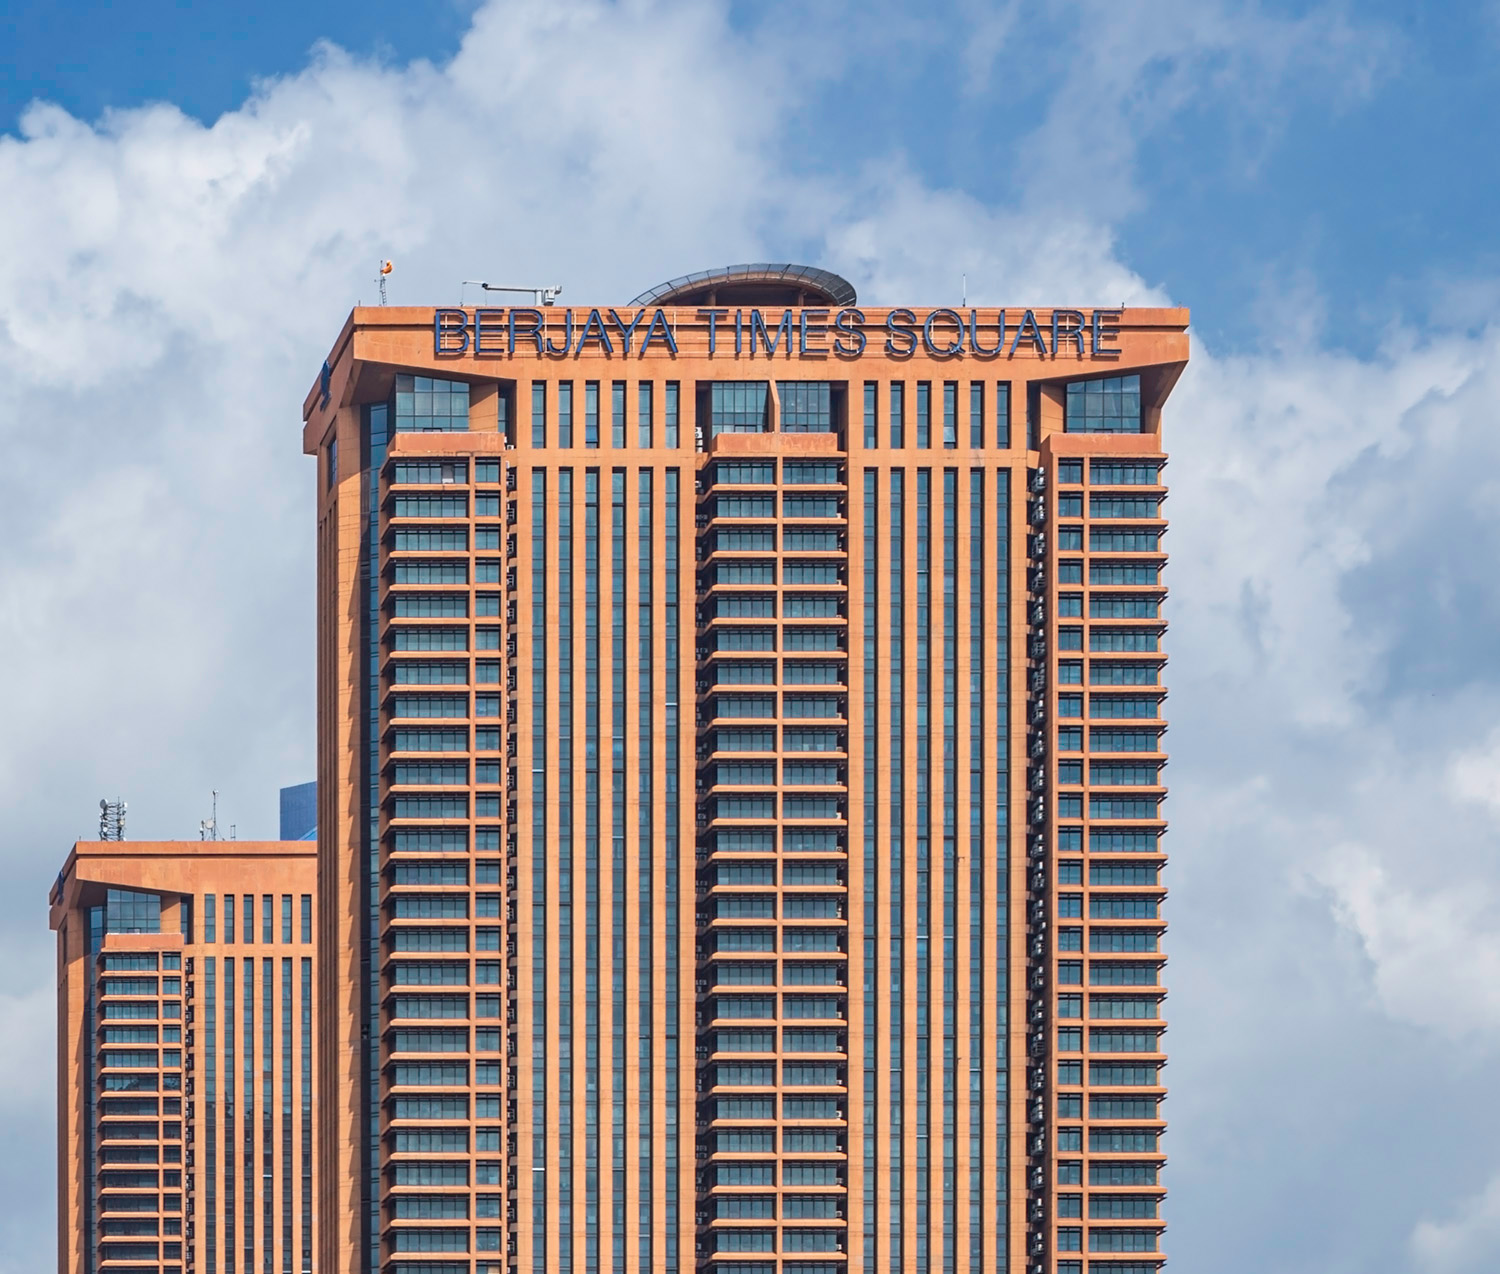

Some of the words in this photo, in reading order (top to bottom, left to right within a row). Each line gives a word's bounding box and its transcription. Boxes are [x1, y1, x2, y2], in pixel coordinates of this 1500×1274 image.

[435, 309, 679, 354] BERJAYA
[697, 309, 867, 354] TIMES
[886, 309, 1122, 355] SQUARE
